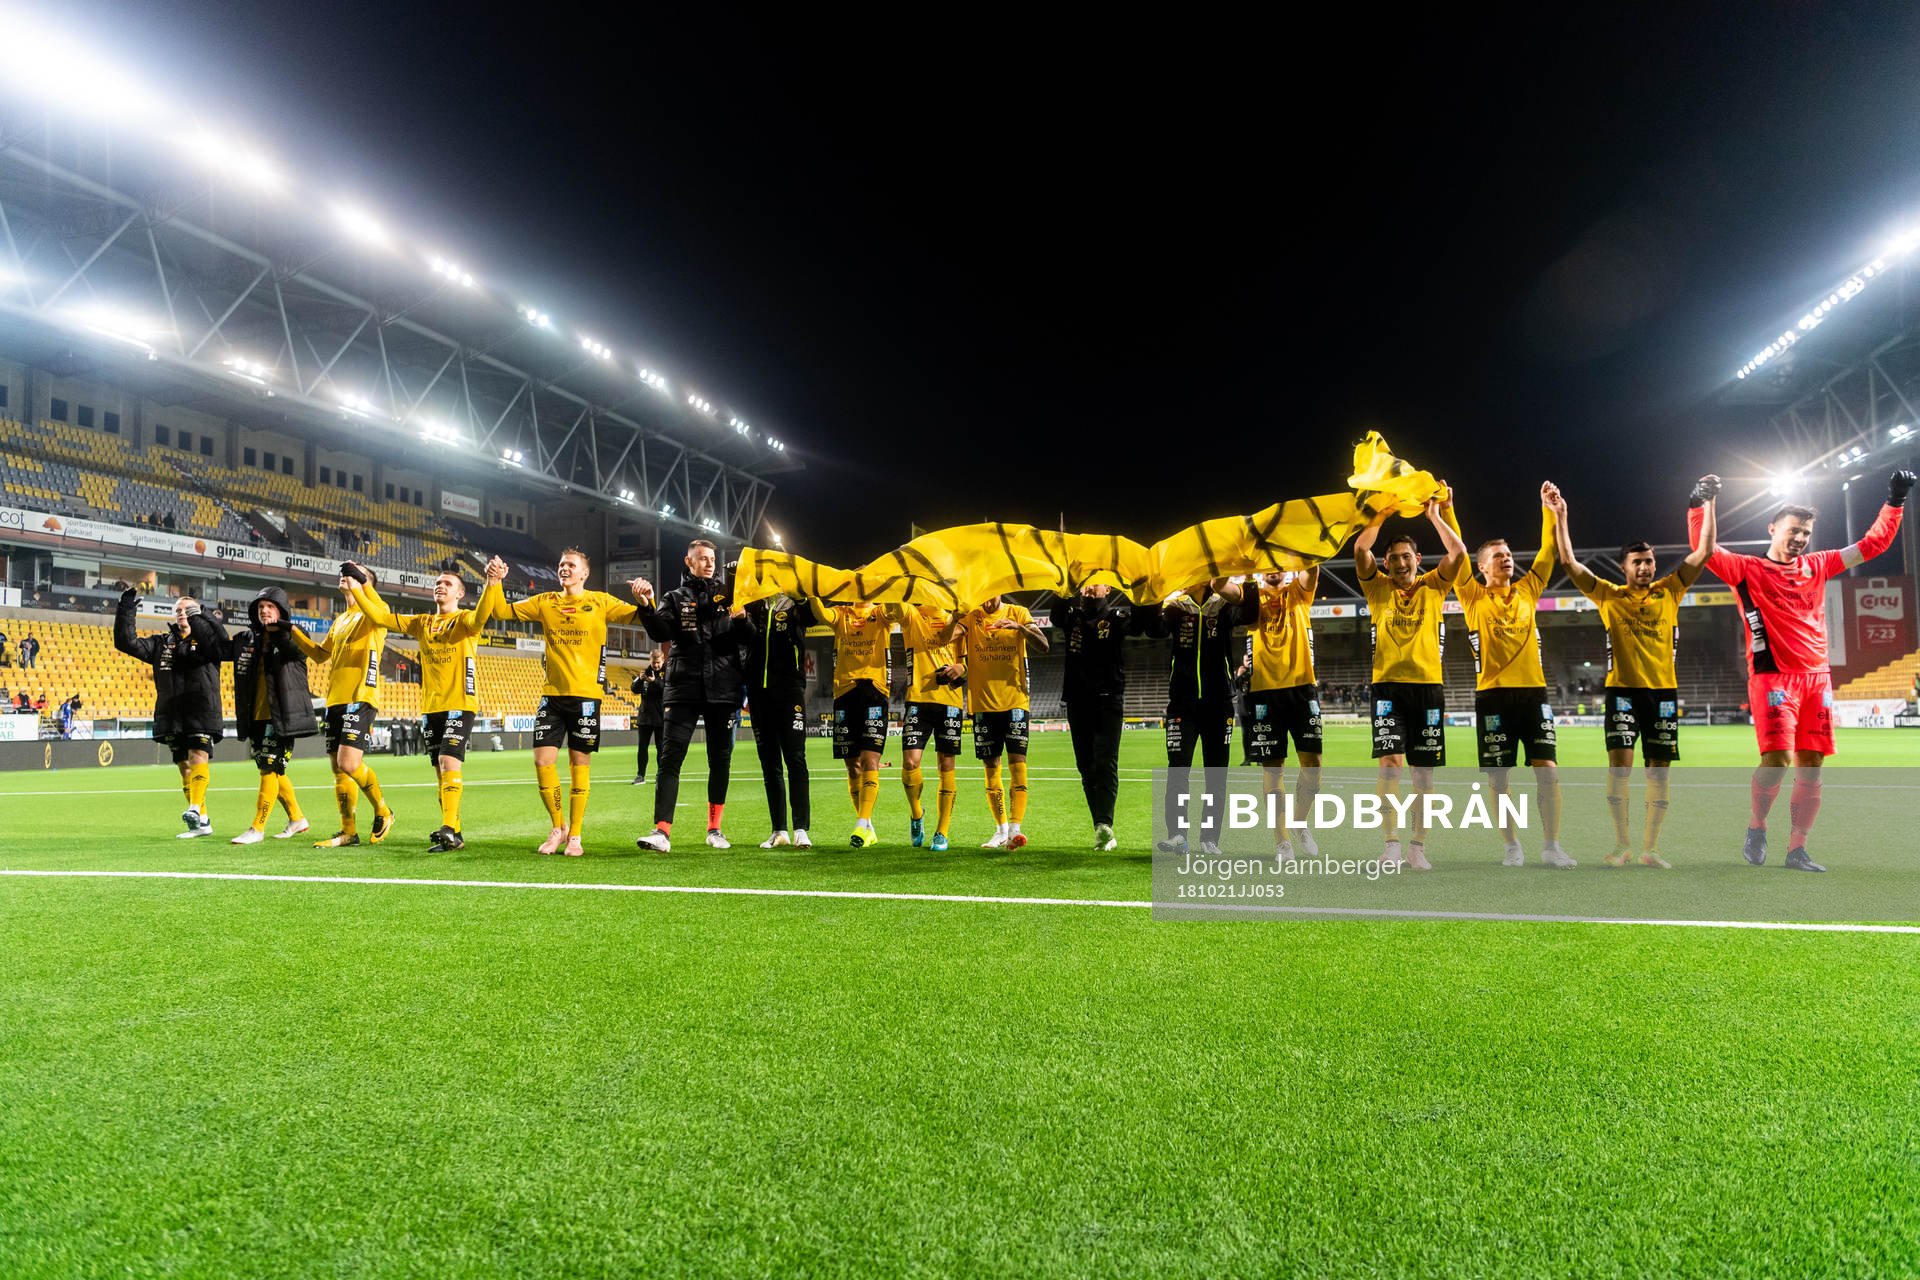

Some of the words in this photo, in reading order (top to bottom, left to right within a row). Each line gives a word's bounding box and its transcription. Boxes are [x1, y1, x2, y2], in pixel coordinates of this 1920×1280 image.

[1374, 715, 1396, 728] ellos
[1612, 712, 1635, 724] ellos
[513, 717, 535, 732] upon
[907, 736, 918, 746] 25
[1382, 740, 1395, 750] 24
[1260, 746, 1271, 757] 14
